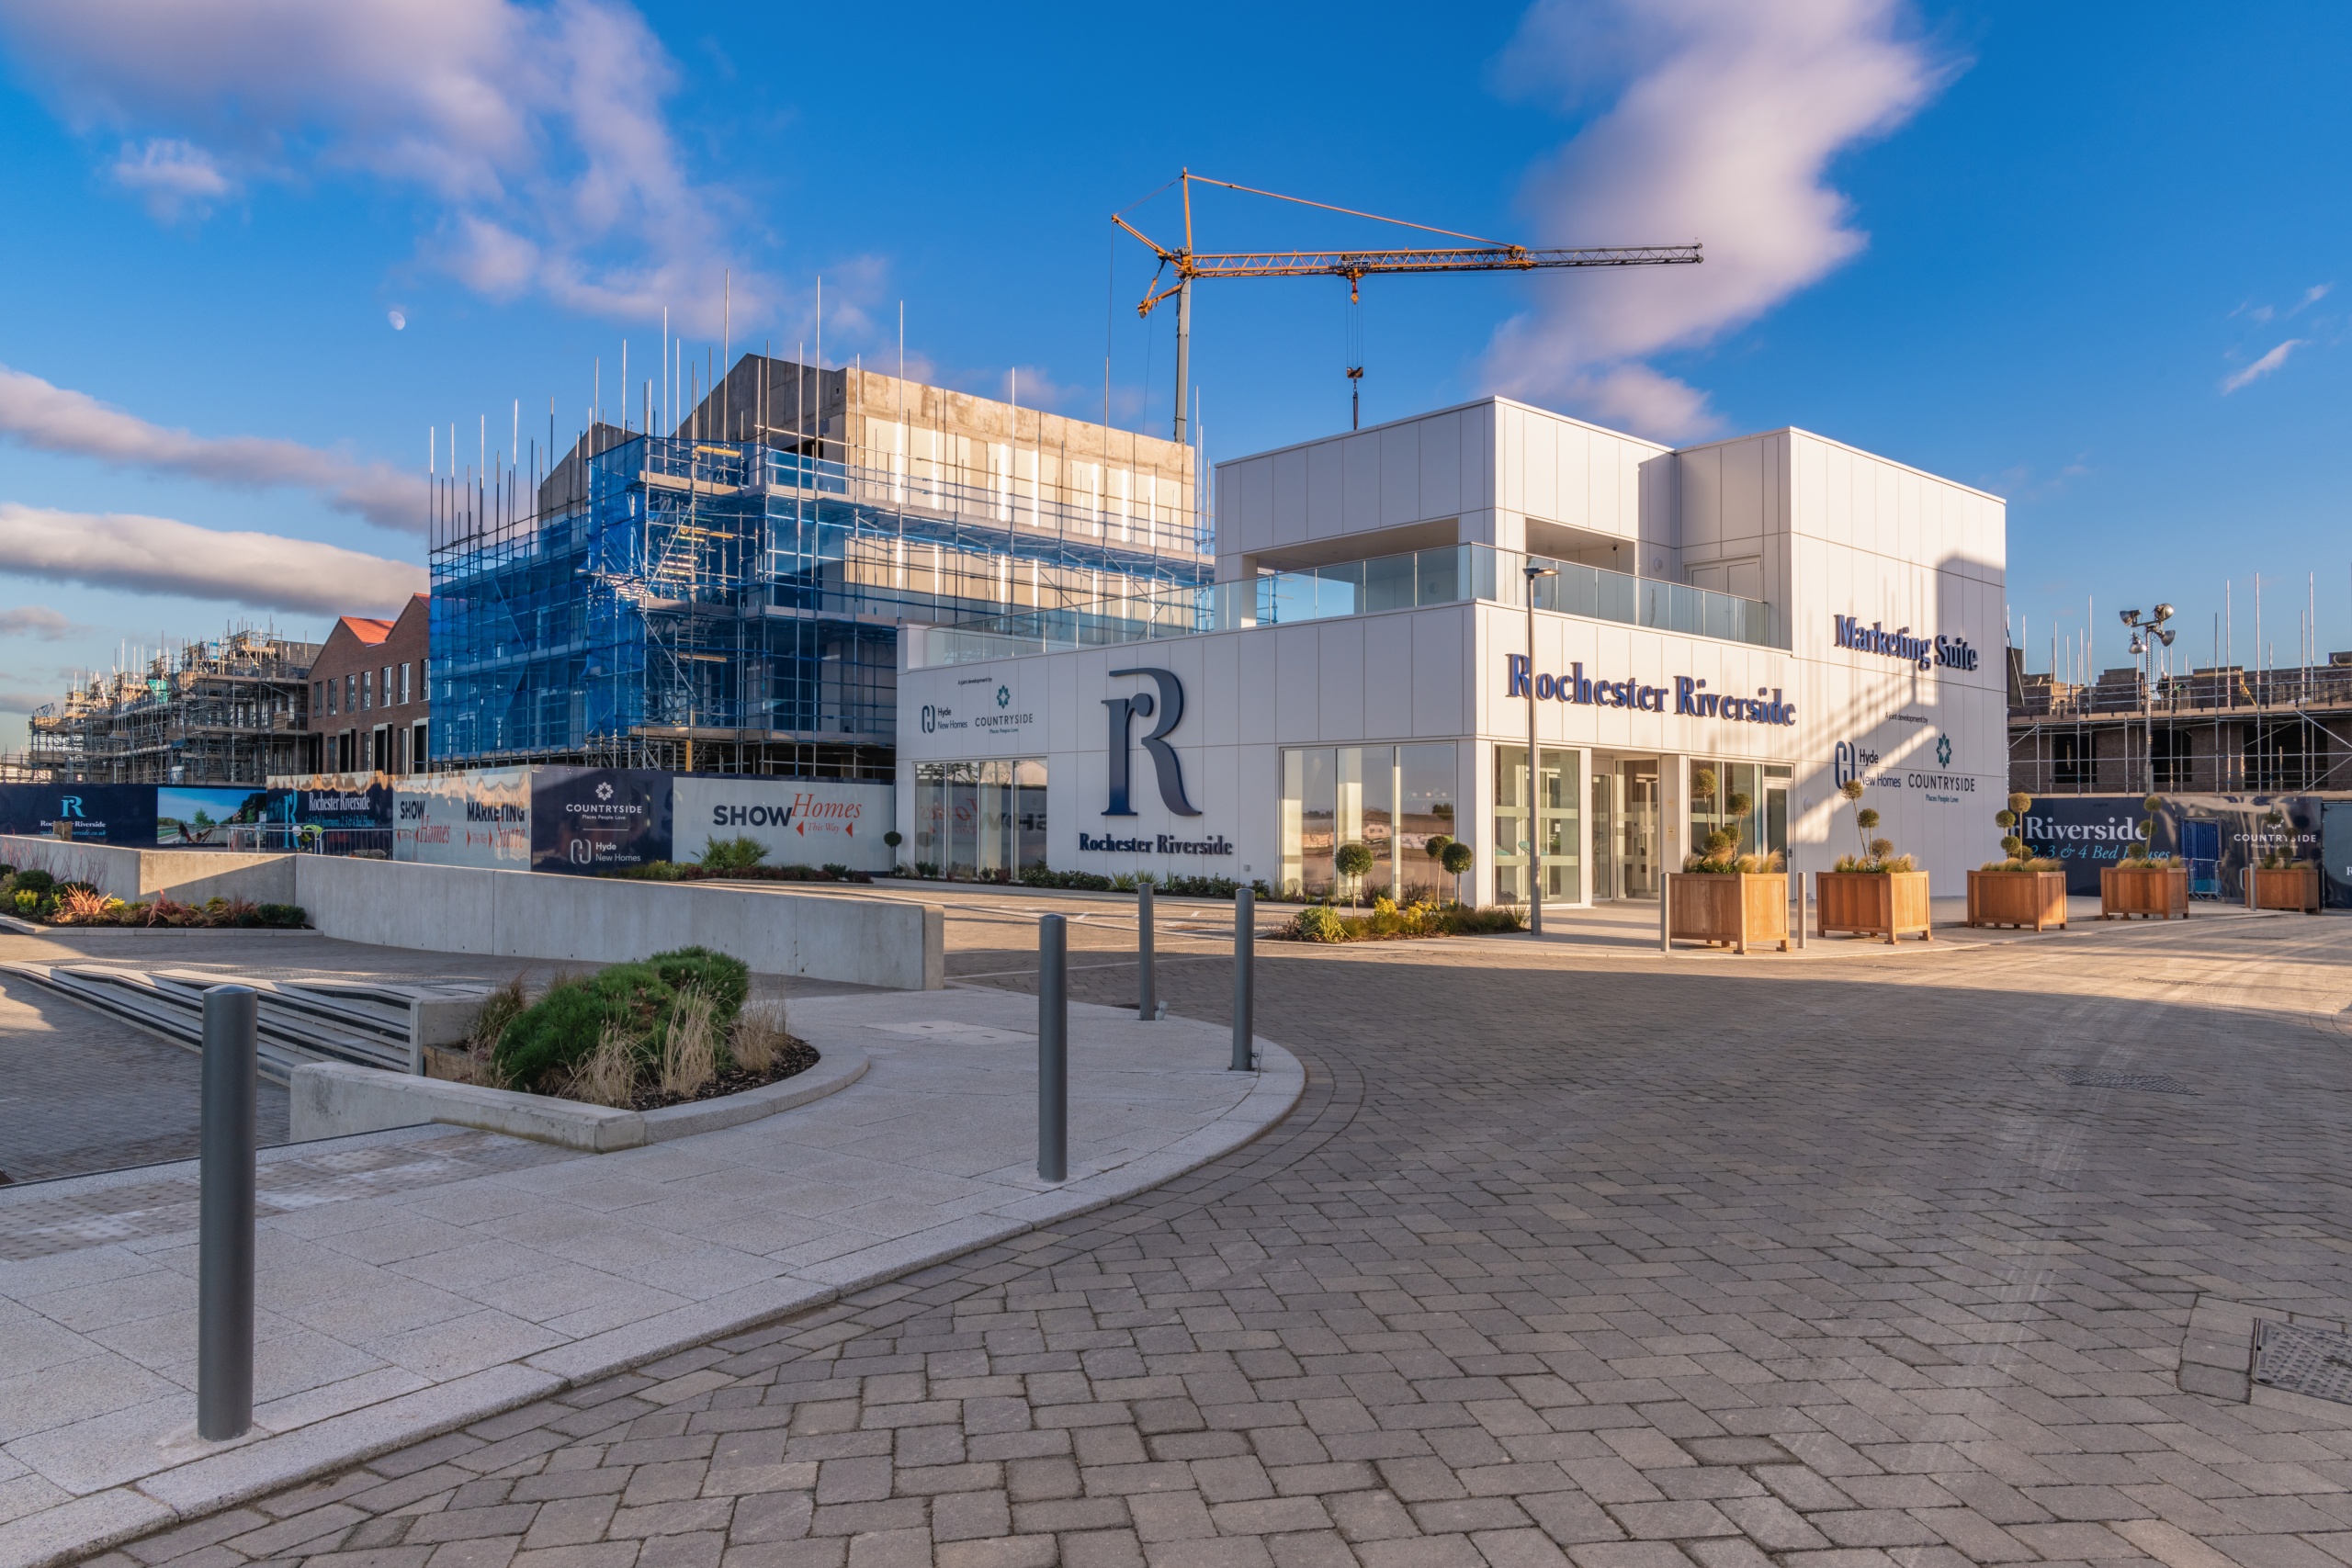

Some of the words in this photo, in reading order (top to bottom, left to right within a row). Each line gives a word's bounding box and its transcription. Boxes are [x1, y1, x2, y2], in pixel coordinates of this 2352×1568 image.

[1834, 615, 1932, 671] Marketing
[1934, 634, 1978, 671] Suite
[1505, 653, 1668, 713] Rochester
[1673, 675, 1796, 727] Riverside
[938, 707, 951, 717] Hyde
[975, 714, 1033, 727] COUNTRYSIDE
[1888, 713, 1897, 721] joint
[1897, 714, 1923, 724] development
[1923, 716, 1928, 725] by
[938, 720, 948, 729] New
[949, 720, 967, 729] Homes
[1860, 749, 1879, 766] Hyde
[1859, 771, 1875, 787] New
[1877, 773, 1901, 788] Homes
[1908, 773, 1974, 792] COUNTRYSIDE
[309, 792, 339, 811] Rochester
[340, 790, 370, 810] Riverside
[1926, 794, 1937, 802] Places
[1937, 795, 1950, 804] People
[1950, 795, 1959, 803] Love
[467, 801, 525, 823] MARKETING
[566, 804, 642, 814] COUNTRYSIDE
[713, 805, 793, 827] SHOW
[790, 793, 863, 818] Homes
[400, 800, 425, 820] SHOW
[419, 815, 450, 844] Homes
[808, 822, 822, 831] This
[825, 822, 840, 834] Way
[495, 817, 526, 849] Suite
[2233, 834, 2317, 842] COUNTRYSIDE
[595, 841, 616, 852] Hyde
[1079, 832, 1153, 853] Rochester
[1156, 834, 1233, 855] Riverside
[2046, 844, 2055, 858] 3
[2061, 843, 2075, 858] &
[2078, 844, 2088, 858] 4
[2092, 844, 2120, 860] Bed
[2122, 844, 2170, 860] uses
[595, 853, 613, 862] New
[615, 853, 641, 862] Homes
